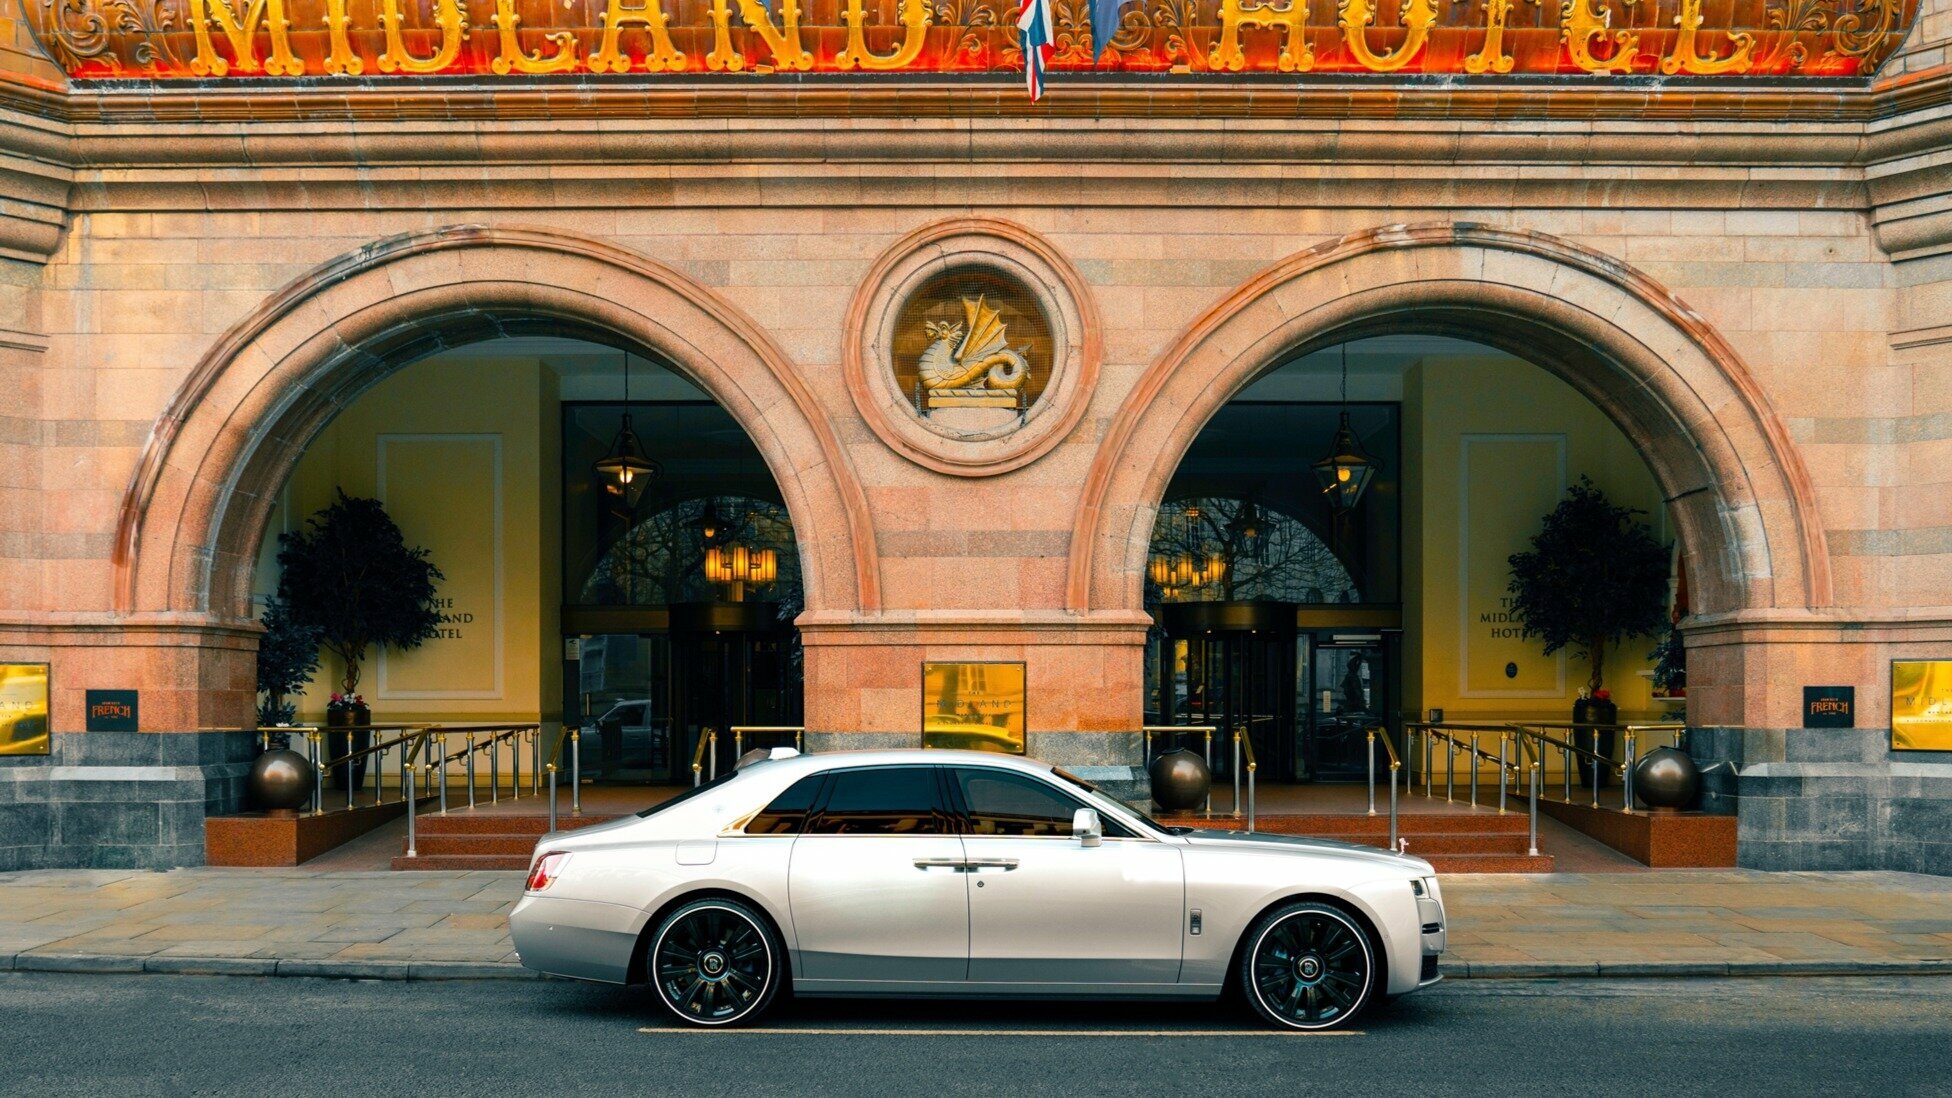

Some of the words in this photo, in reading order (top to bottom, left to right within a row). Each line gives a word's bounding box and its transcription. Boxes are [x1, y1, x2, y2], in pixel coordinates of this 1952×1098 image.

[188, 0, 933, 76] MIDLAND
[1208, 0, 1756, 75] HOTEL
[1500, 597, 1519, 608] TH
[1480, 612, 1525, 623] MIDLA
[92, 705, 131, 719] FRENCH
[1811, 701, 1849, 715] FRENCH
